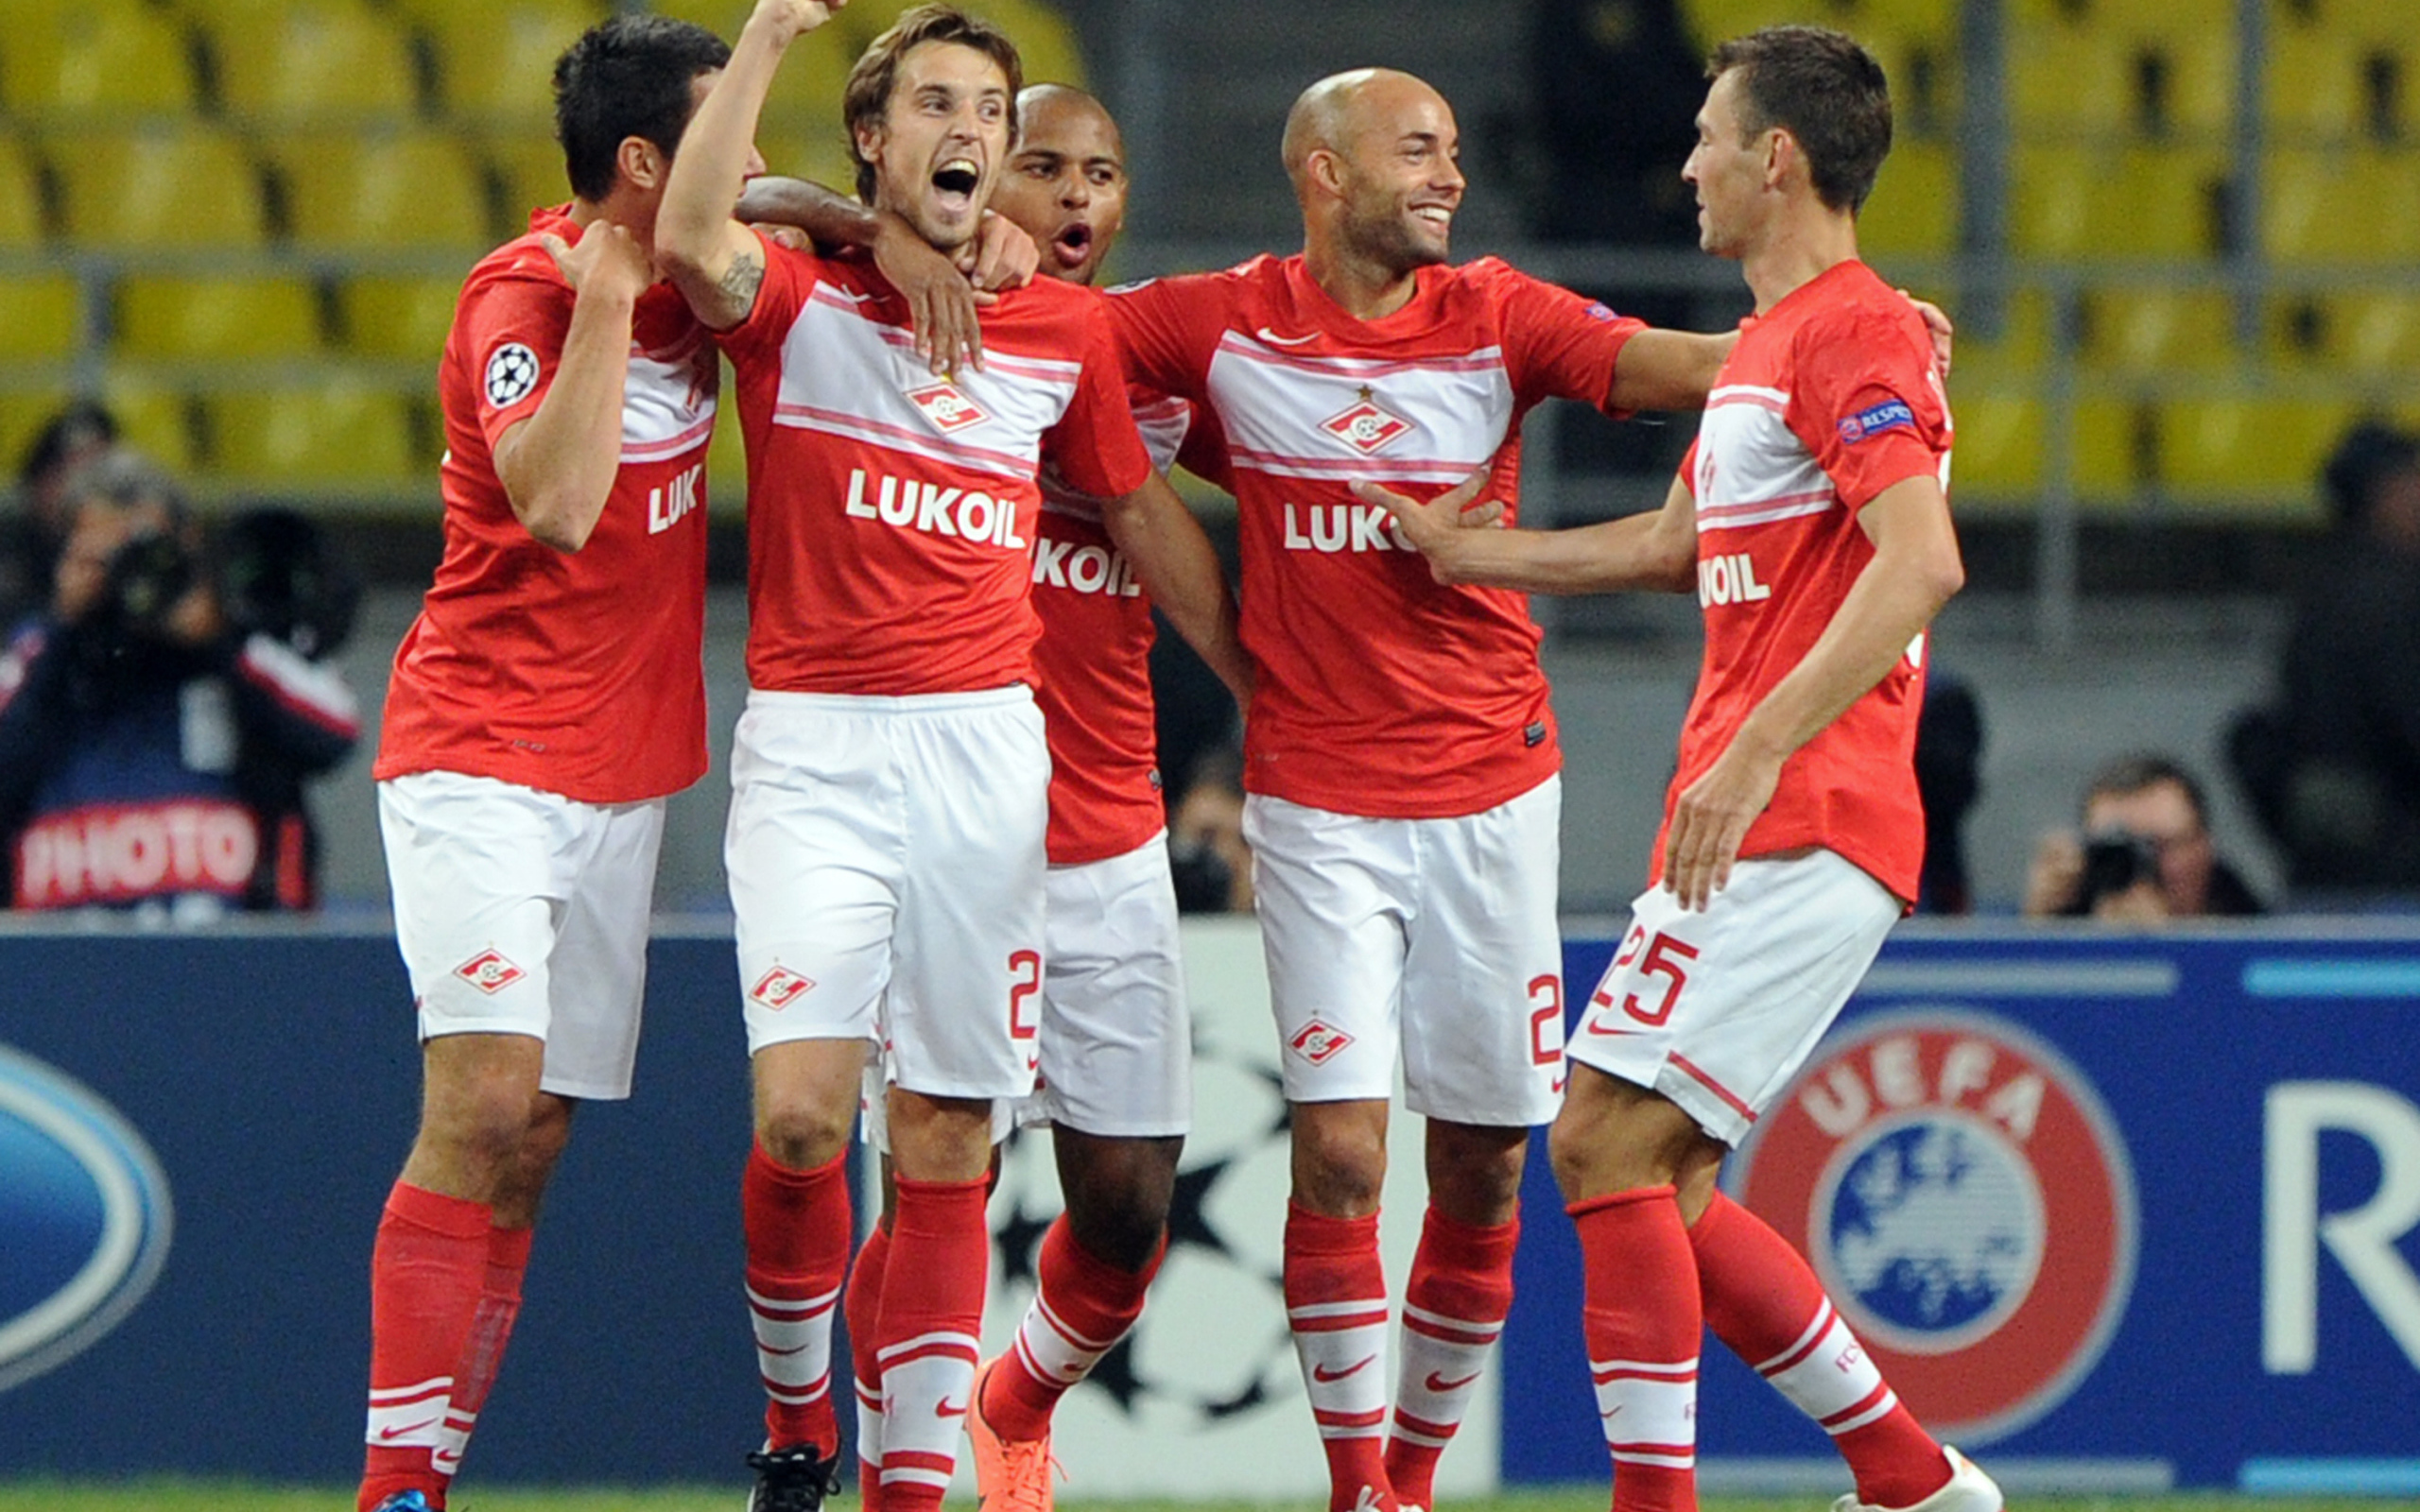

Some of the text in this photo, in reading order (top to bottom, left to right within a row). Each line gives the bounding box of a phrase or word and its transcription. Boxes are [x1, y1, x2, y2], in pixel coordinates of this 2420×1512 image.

[846, 469, 1026, 548] LUKOIL
[22, 806, 257, 900] PHOTO
[1009, 950, 1041, 1039] 2
[1529, 974, 1562, 1065] 2
[1593, 924, 1700, 1027] 25
[1797, 1038, 2045, 1140] UEFA
[2263, 1081, 2420, 1373] R
